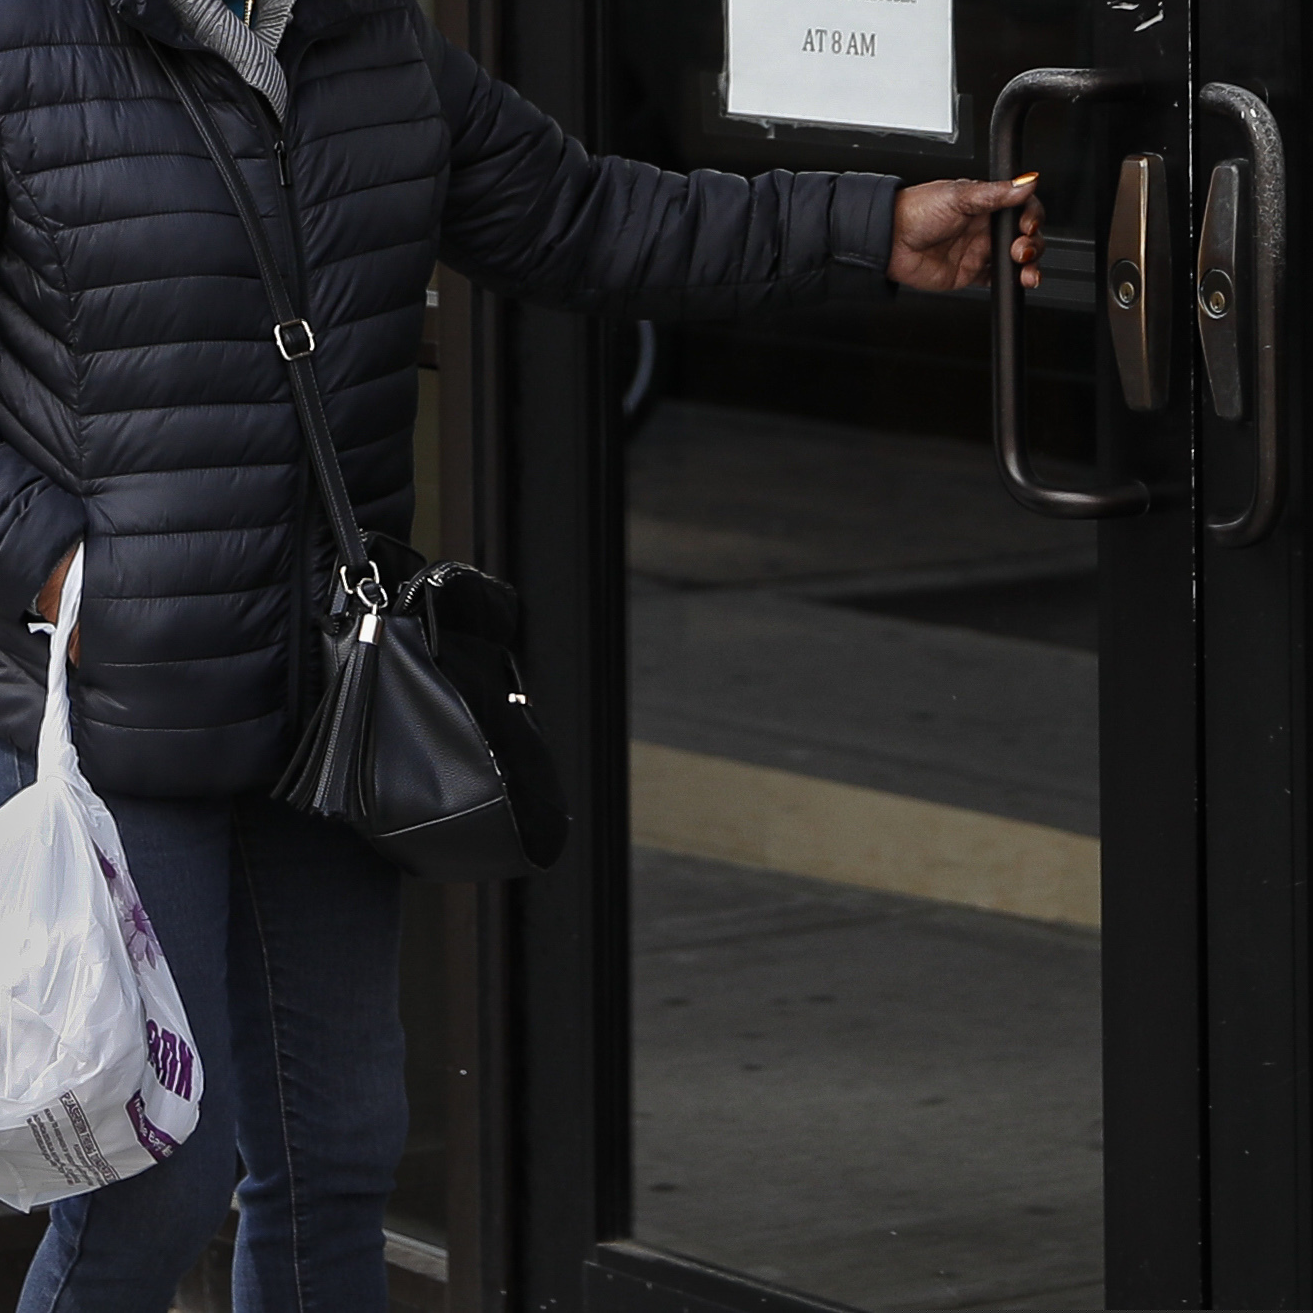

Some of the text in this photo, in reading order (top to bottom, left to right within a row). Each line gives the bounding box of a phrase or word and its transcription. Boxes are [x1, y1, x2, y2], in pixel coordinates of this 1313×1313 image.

[802, 29, 876, 56] AT 8 AM
